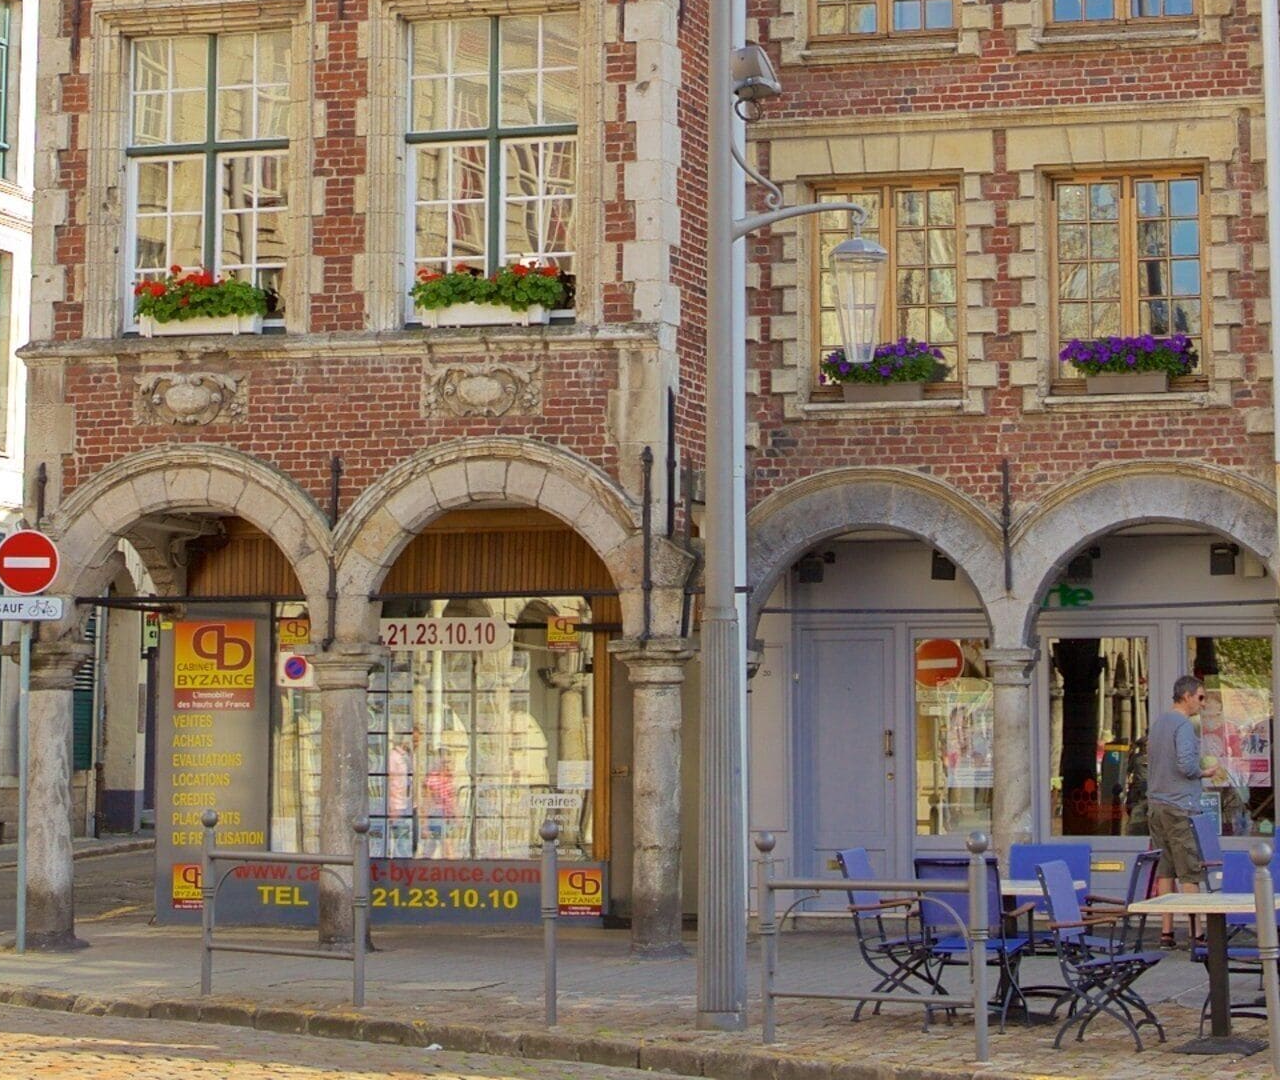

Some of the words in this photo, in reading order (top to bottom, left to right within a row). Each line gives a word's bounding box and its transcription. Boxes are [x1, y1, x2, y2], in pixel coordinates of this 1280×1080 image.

[177, 663, 214, 671] CABINET
[177, 674, 253, 686] BYZANCE
[173, 715, 212, 728] VENTES
[173, 734, 213, 747] ACHATS
[173, 754, 242, 767] EVALUATIONS
[173, 773, 230, 786] LOCATIONS
[173, 793, 216, 805] CREDITS
[173, 832, 186, 845] DE
[188, 831, 264, 845] FISLISATION
[257, 885, 309, 906] TEL
